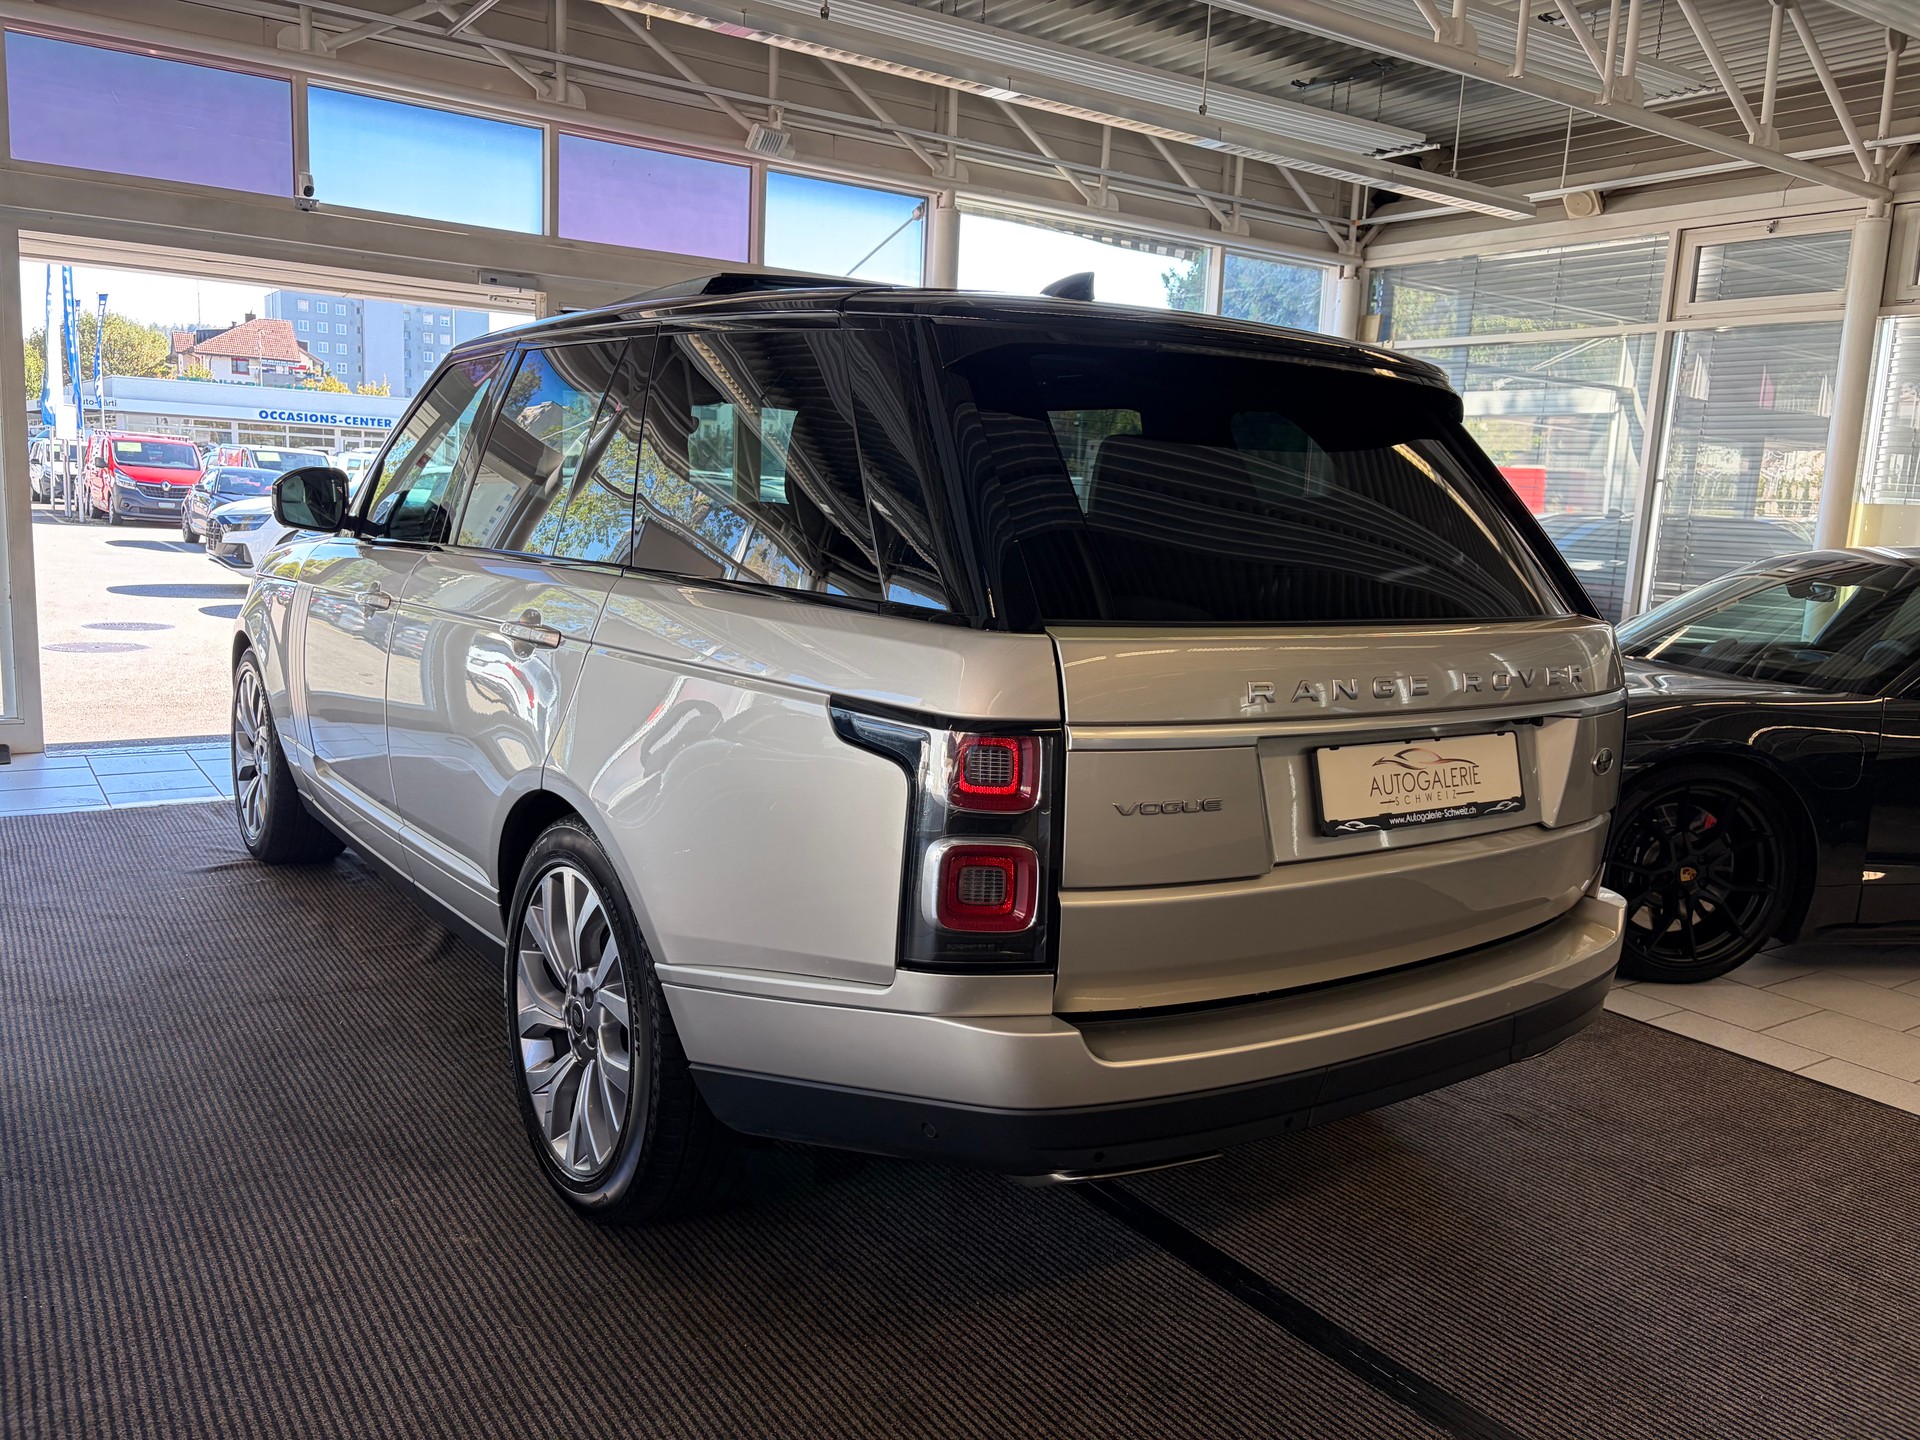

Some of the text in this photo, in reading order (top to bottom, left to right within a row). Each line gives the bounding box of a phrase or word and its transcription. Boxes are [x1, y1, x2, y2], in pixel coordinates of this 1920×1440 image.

[258, 410, 392, 428] OCCASIONS-CENTER
[1247, 664, 1583, 704] RANGE ROVER
[1369, 765, 1482, 798] AUTOGALERIE
[1112, 797, 1223, 816] VOGUE
[1395, 789, 1457, 806] SCHWEIZ
[1389, 806, 1477, 825] www.Autogalerie-Schweiz.ch
